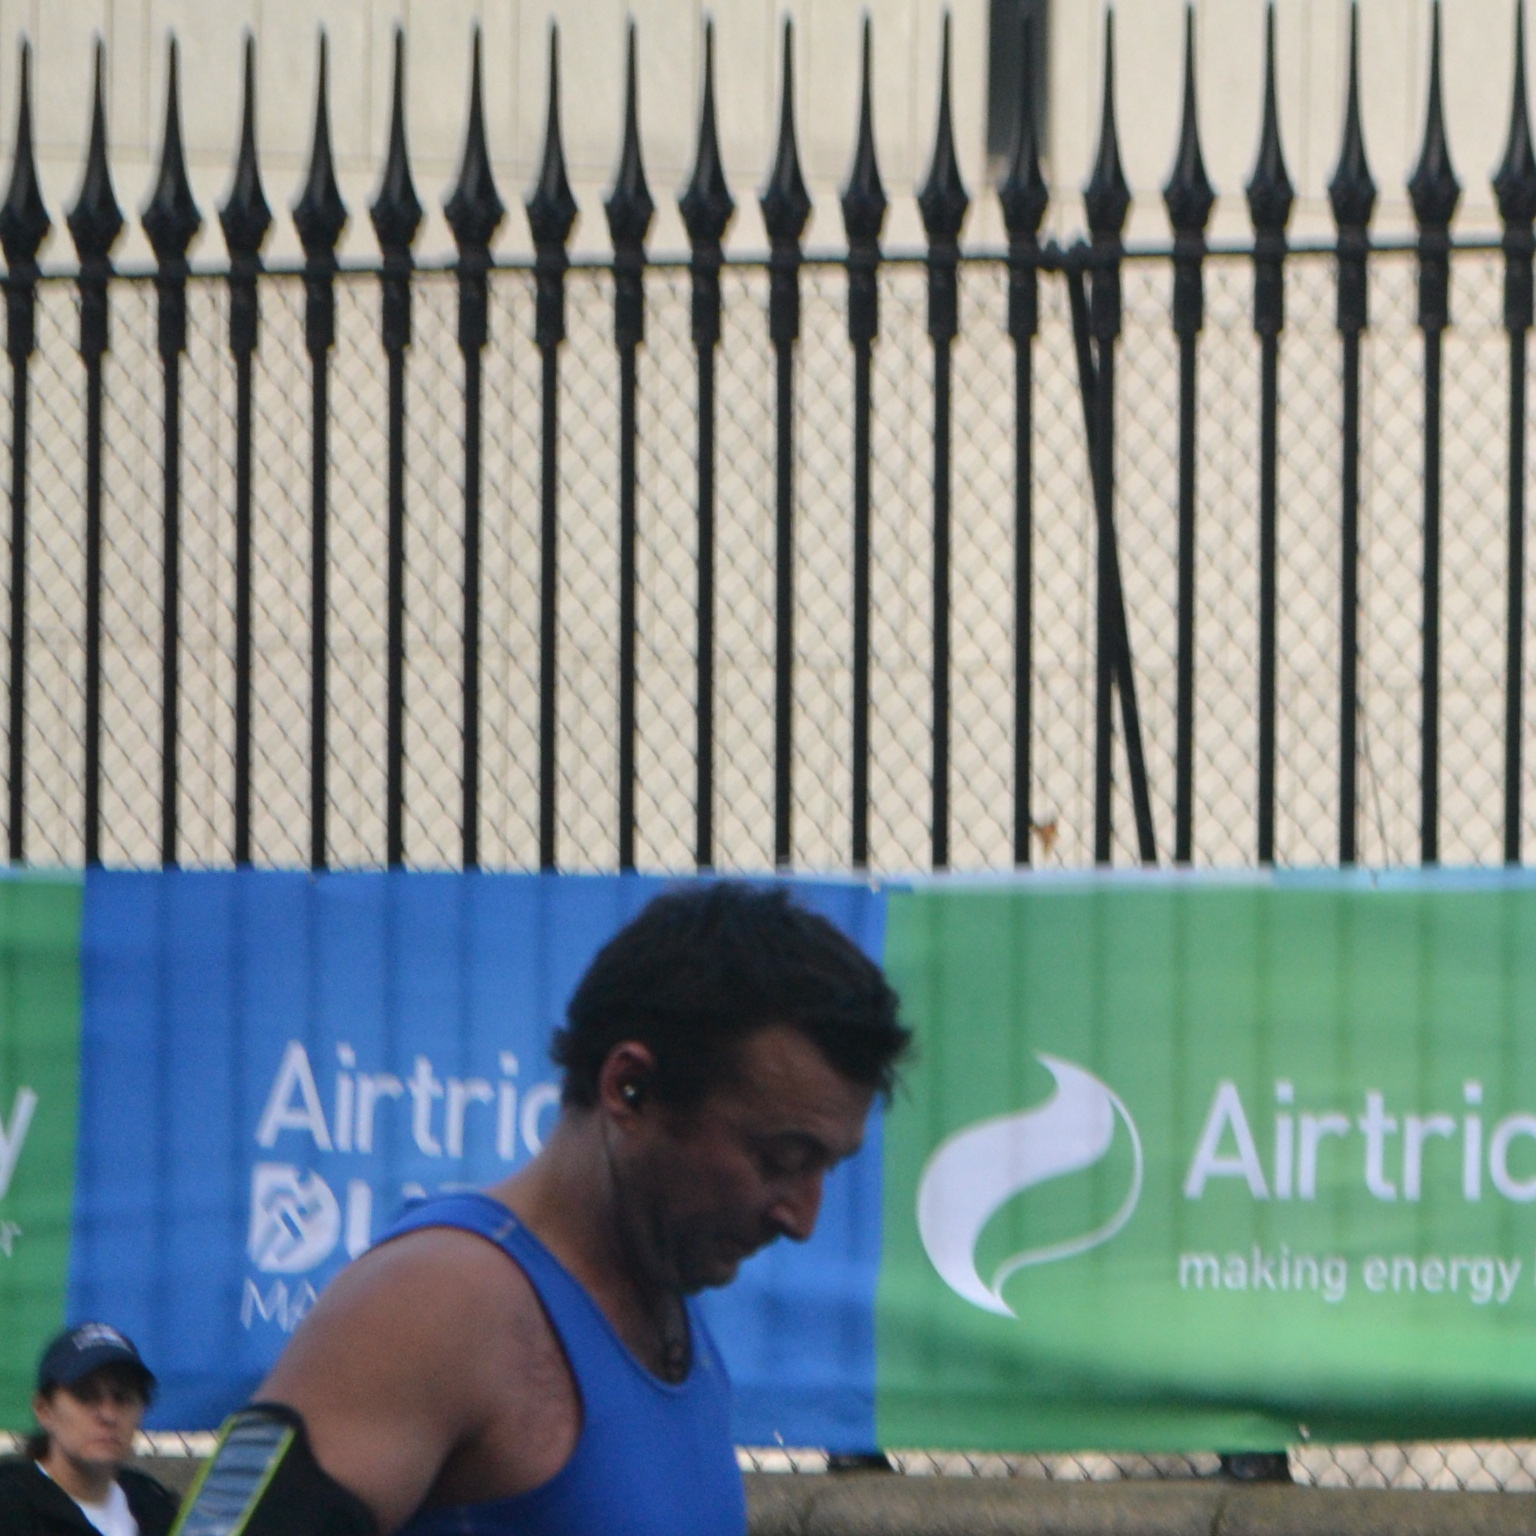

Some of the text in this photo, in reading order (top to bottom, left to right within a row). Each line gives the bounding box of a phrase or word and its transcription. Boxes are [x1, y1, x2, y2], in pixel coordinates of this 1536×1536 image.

[255, 1040, 563, 1160] Airtric
[1179, 1246, 1348, 1301] making
[1363, 1252, 1520, 1304] energy
